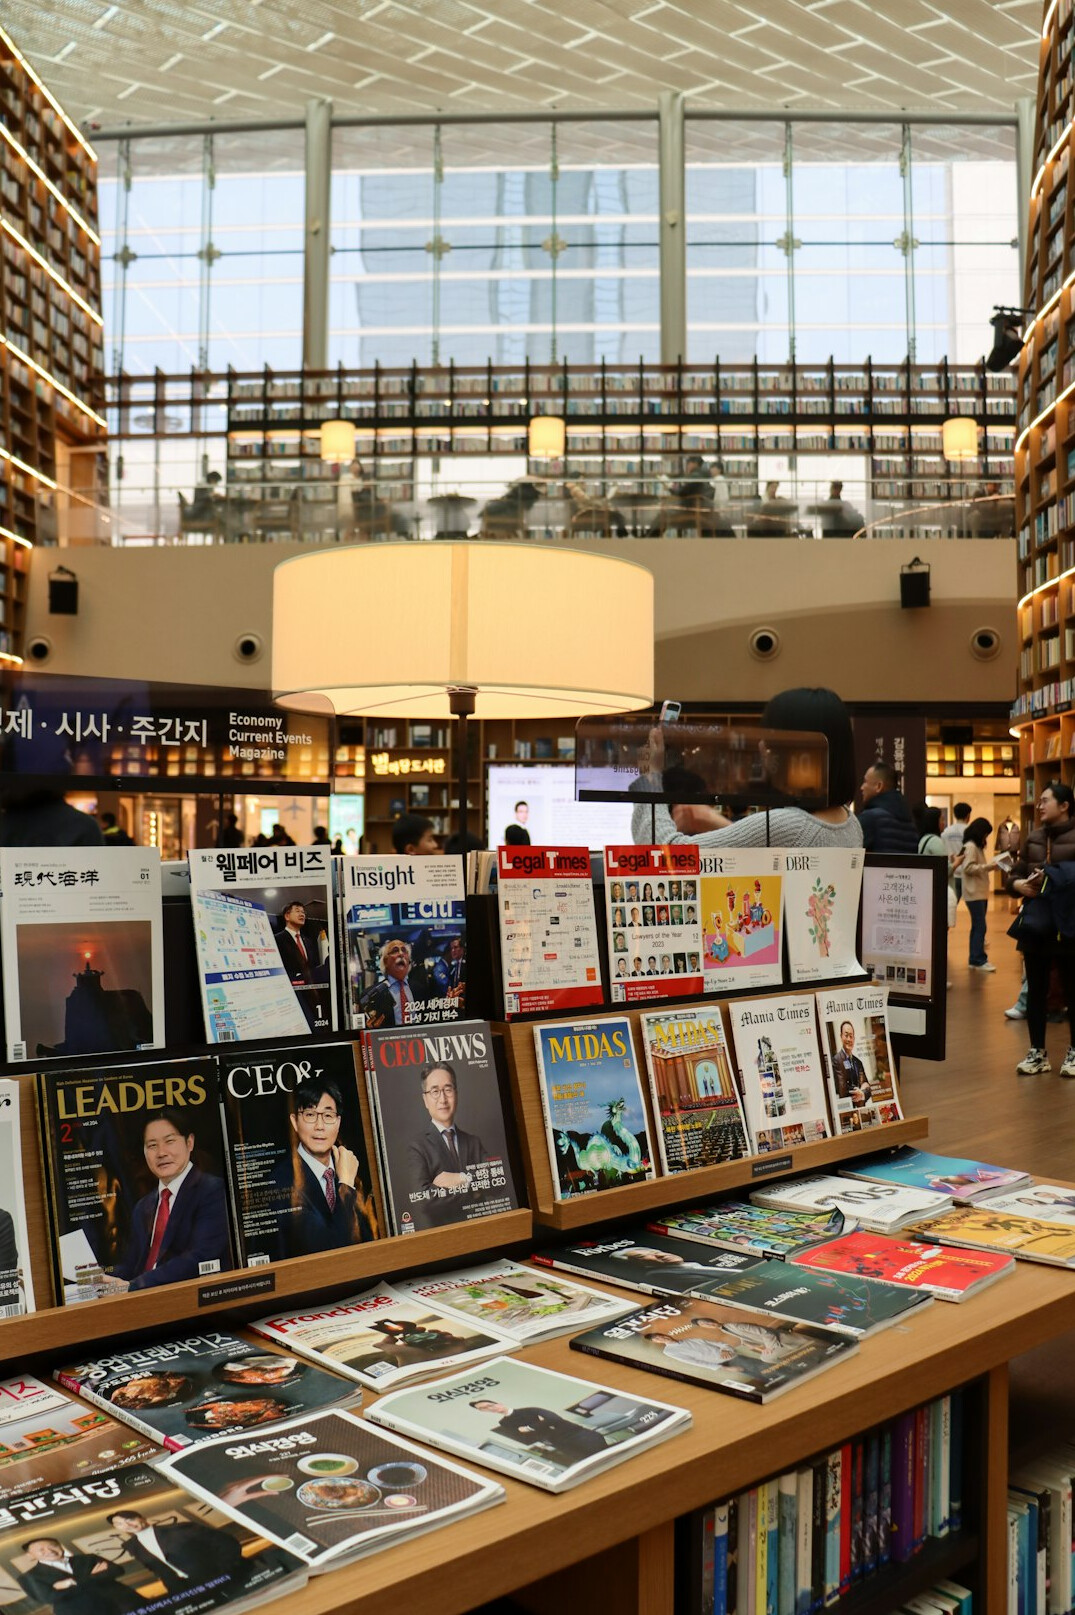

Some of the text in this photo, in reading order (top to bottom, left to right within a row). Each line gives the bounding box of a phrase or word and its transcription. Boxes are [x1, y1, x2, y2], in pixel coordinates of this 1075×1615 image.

[0, 708, 33, 740] 제
[229, 712, 283, 728] Economy
[229, 729, 312, 745] Current Events
[229, 745, 285, 760] Magazine
[216, 851, 326, 882] 웰페어 비즈
[501, 851, 587, 873] Legal Times
[608, 851, 650, 871] Legal
[786, 856, 810, 871] DBR
[15, 869, 99, 887] 現代海洋
[351, 865, 415, 890] Insight
[631, 932, 653, 940] Lawyers
[315, 1004, 323, 1019] 1
[404, 1001, 425, 1012] 2024
[826, 998, 884, 1015] Mania Times
[314, 1019, 329, 1027] 2024
[423, 1012, 440, 1022] 가지
[741, 1008, 810, 1027] Mania Times
[654, 1019, 719, 1050] MIDAS
[380, 1033, 487, 1068] CEONEWS
[548, 1031, 627, 1063] MIDAS
[57, 1075, 207, 1119] LEADERS
[60, 1123, 73, 1143] 2
[492, 1177, 506, 1186] CEO
[571, 1239, 635, 1257] Forbes
[412, 1280, 457, 1294] HOTEL
[420, 1274, 506, 1297] RESTAURANT
[265, 1295, 393, 1334] Franchise
[603, 1305, 682, 1340] 월간식당
[427, 1376, 500, 1403] 외식경영
[225, 1431, 317, 1460] 외식경영
